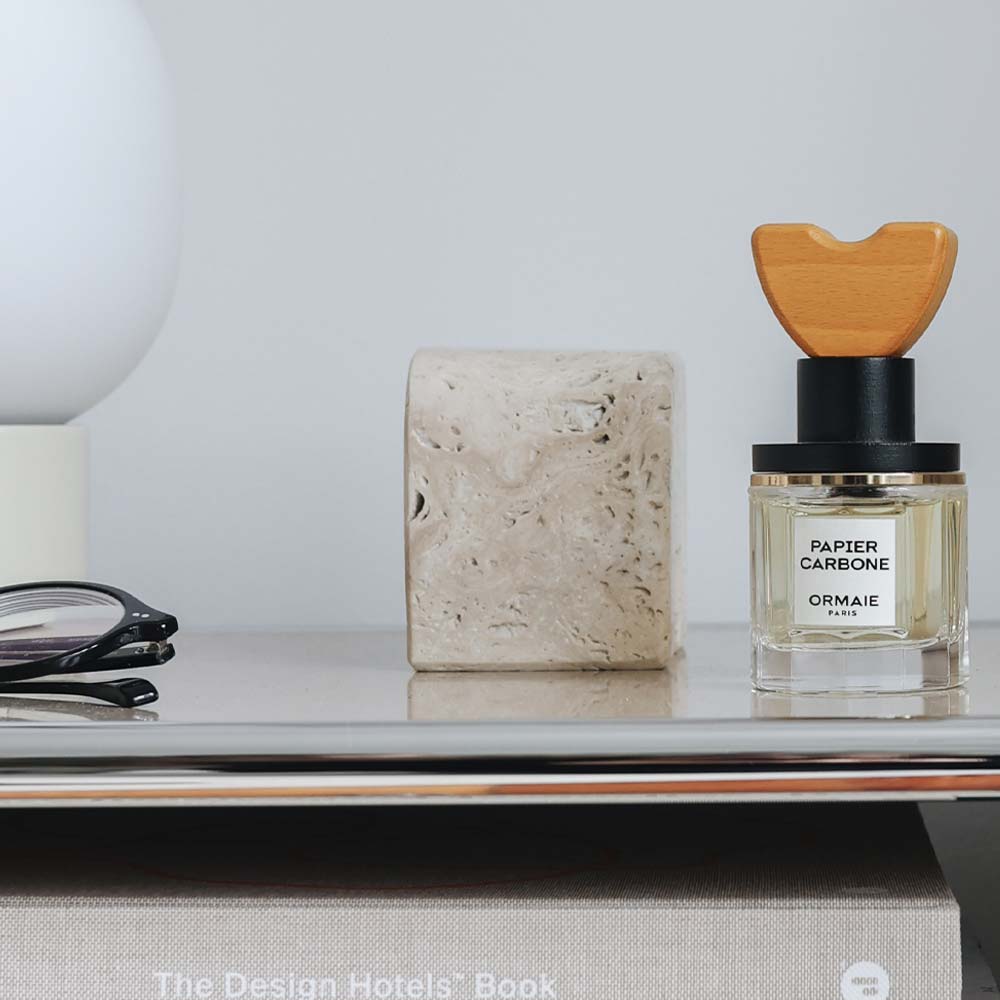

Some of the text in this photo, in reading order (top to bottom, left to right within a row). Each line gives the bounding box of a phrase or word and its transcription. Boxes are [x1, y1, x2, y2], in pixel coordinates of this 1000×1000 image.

[811, 540, 878, 553] PAPIER
[800, 557, 889, 571] CARBONE
[809, 594, 879, 607] ORMAIE
[153, 972, 214, 998] The
[474, 972, 559, 998] Book
